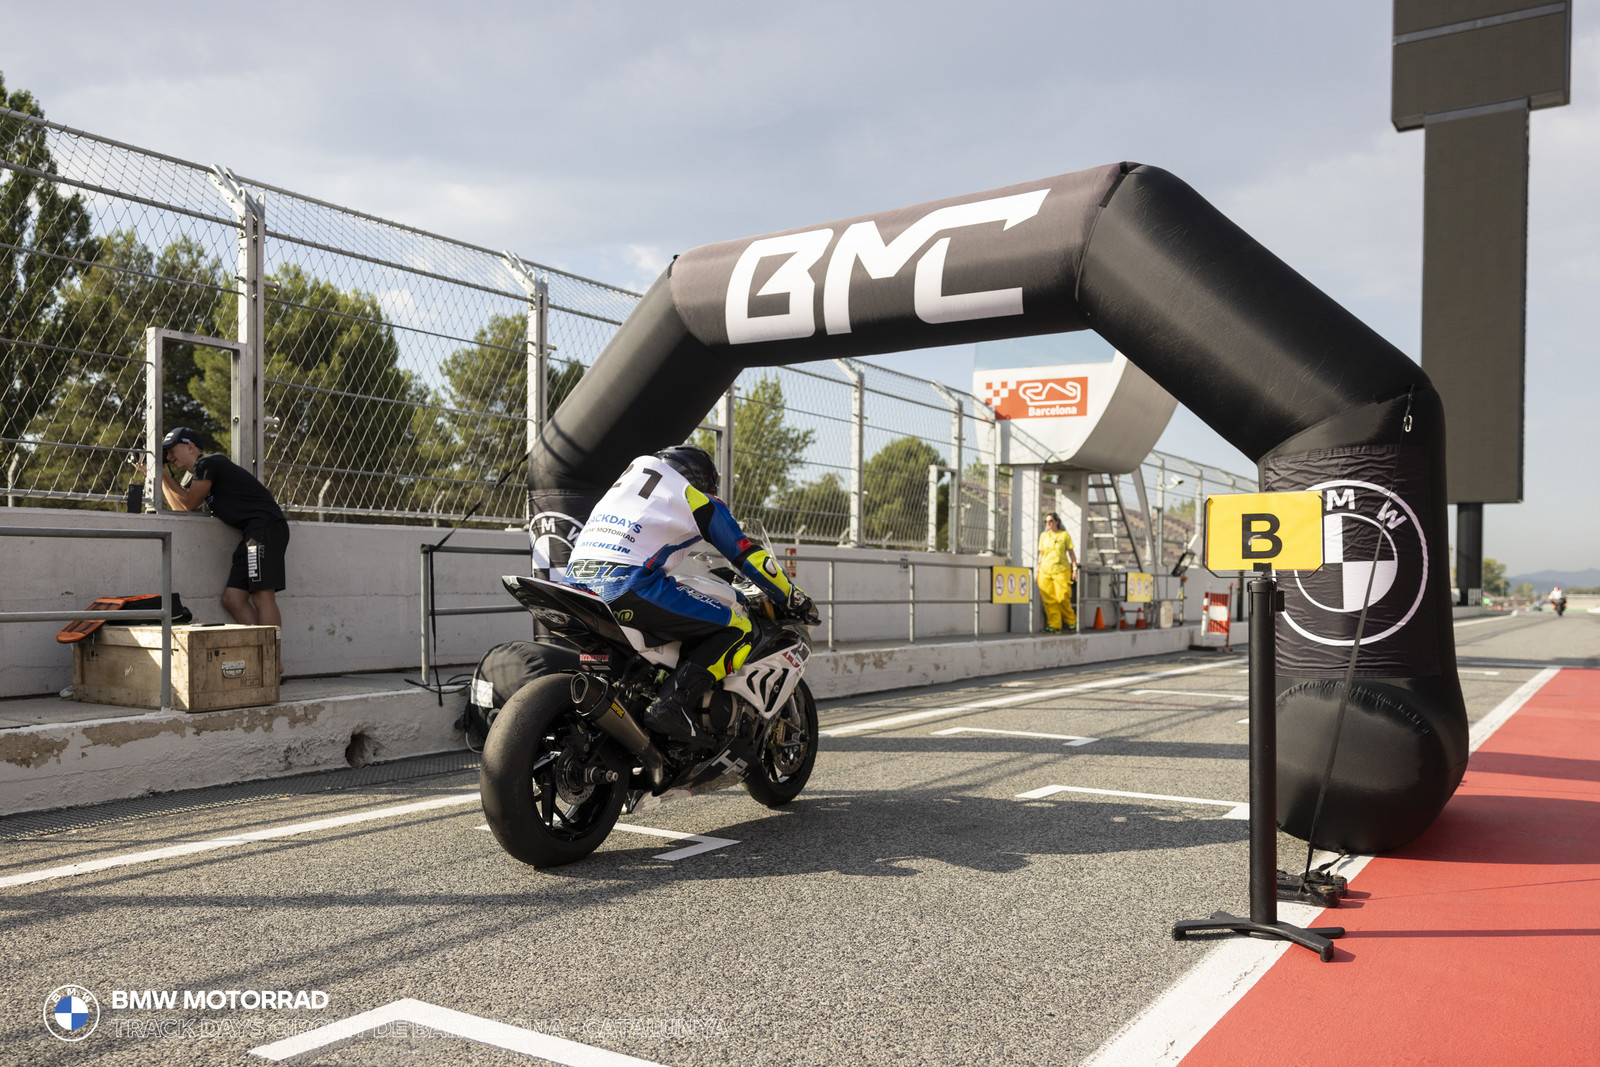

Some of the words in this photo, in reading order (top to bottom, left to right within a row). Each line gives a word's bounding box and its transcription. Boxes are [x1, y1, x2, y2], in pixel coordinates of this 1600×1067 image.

[725, 188, 1051, 345] BMC
[1028, 405, 1077, 417] Barcelona
[588, 513, 643, 534] ACKDAYS
[596, 527, 636, 543] MOTORRAD
[1241, 513, 1283, 559] B
[580, 541, 631, 555] MICHELIN
[566, 559, 631, 579] RST
